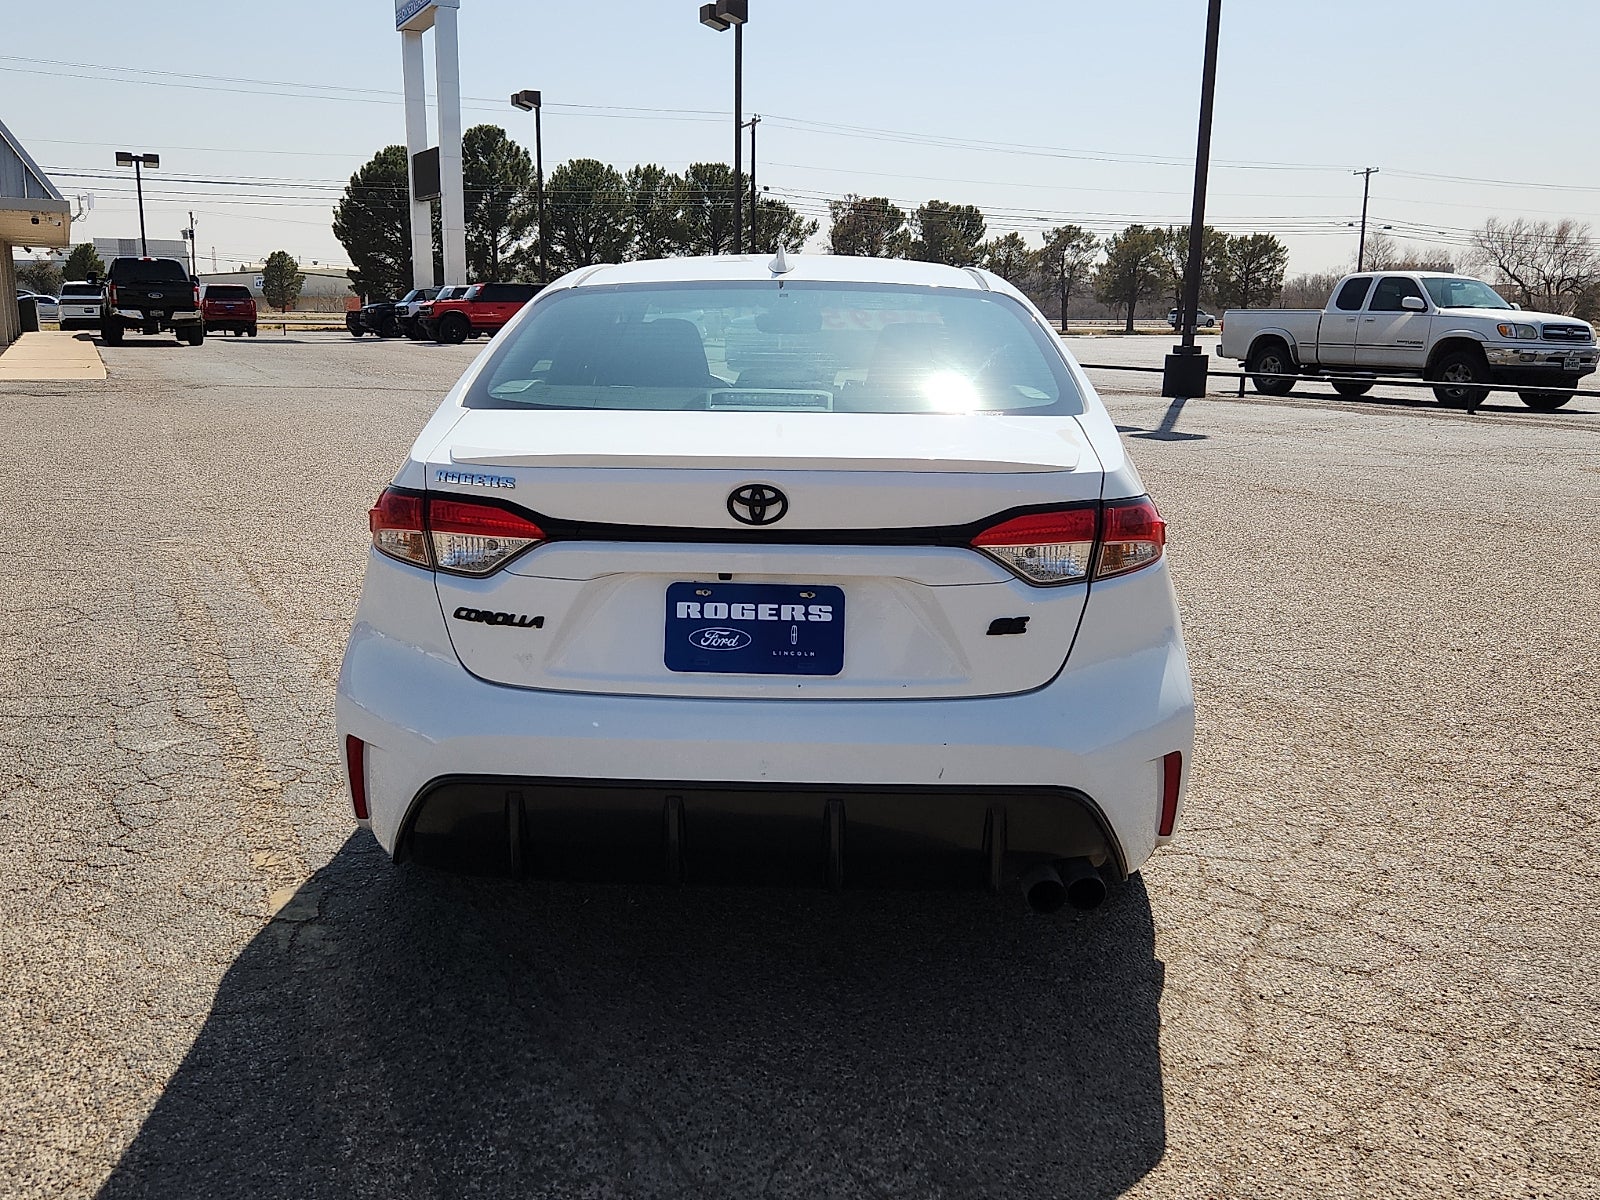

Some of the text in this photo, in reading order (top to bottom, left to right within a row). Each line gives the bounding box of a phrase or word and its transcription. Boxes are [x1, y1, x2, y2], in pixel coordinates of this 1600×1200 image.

[434, 469, 516, 489] ROGERS
[453, 607, 545, 629] COROLLA
[676, 601, 833, 622] ROGERS
[700, 629, 740, 647] Ford
